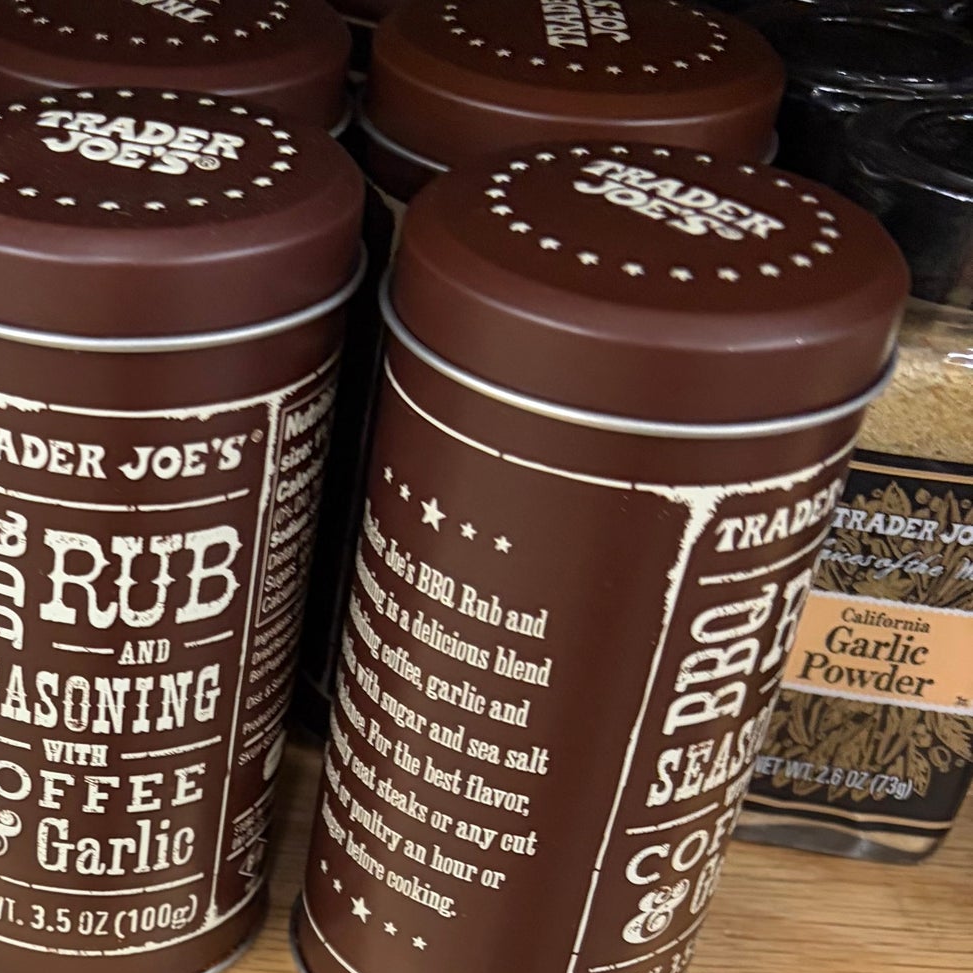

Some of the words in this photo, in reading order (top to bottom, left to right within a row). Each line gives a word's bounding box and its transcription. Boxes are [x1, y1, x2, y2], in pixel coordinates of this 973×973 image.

[541, 0, 588, 49] TRAD
[36, 110, 245, 160] TRADER
[41, 131, 198, 175] JOE'S
[573, 180, 715, 236] JOE'S
[580, 159, 785, 239] TRADER
[117, 432, 249, 481] JOE'S
[831, 506, 939, 542] TRADER
[39, 524, 244, 630] RUB
[415, 560, 456, 609] BBQ
[457, 583, 503, 627] Rub
[504, 608, 549, 640] and
[385, 591, 400, 623] is
[398, 609, 411, 633] a
[411, 609, 491, 670] delicious
[492, 645, 553, 688] blend
[824, 625, 930, 666] Garlic
[841, 607, 932, 634] California
[117, 638, 171, 666] AND
[661, 582, 779, 736] BBQ
[795, 650, 936, 698] Powder
[380, 643, 424, 692] coffee,
[424, 673, 487, 715] garlic
[487, 698, 531, 728] and
[355, 661, 381, 705] with
[379, 691, 428, 735] sugar
[428, 724, 466, 754] and
[466, 735, 501, 766] sea
[503, 746, 550, 776] salt
[42, 738, 109, 768] WITH
[392, 739, 421, 777] the
[423, 754, 462, 795] best
[350, 754, 377, 791] coat
[375, 777, 428, 824] steaks
[430, 810, 454, 834] or
[454, 819, 499, 851] any
[499, 830, 538, 857] cut
[816, 765, 842, 786] 2.6
[869, 773, 914, 800] (73g)
[35, 816, 196, 877] Garlic
[348, 797, 404, 853] poultry
[403, 838, 427, 865] an
[428, 844, 479, 883] hour
[480, 868, 507, 890] or
[345, 829, 385, 881] before
[385, 869, 457, 919] cooking.
[29, 904, 73, 935] 3.5
[77, 910, 109, 937] OZ
[114, 893, 199, 939] (100g)
[621, 877, 691, 945] &
